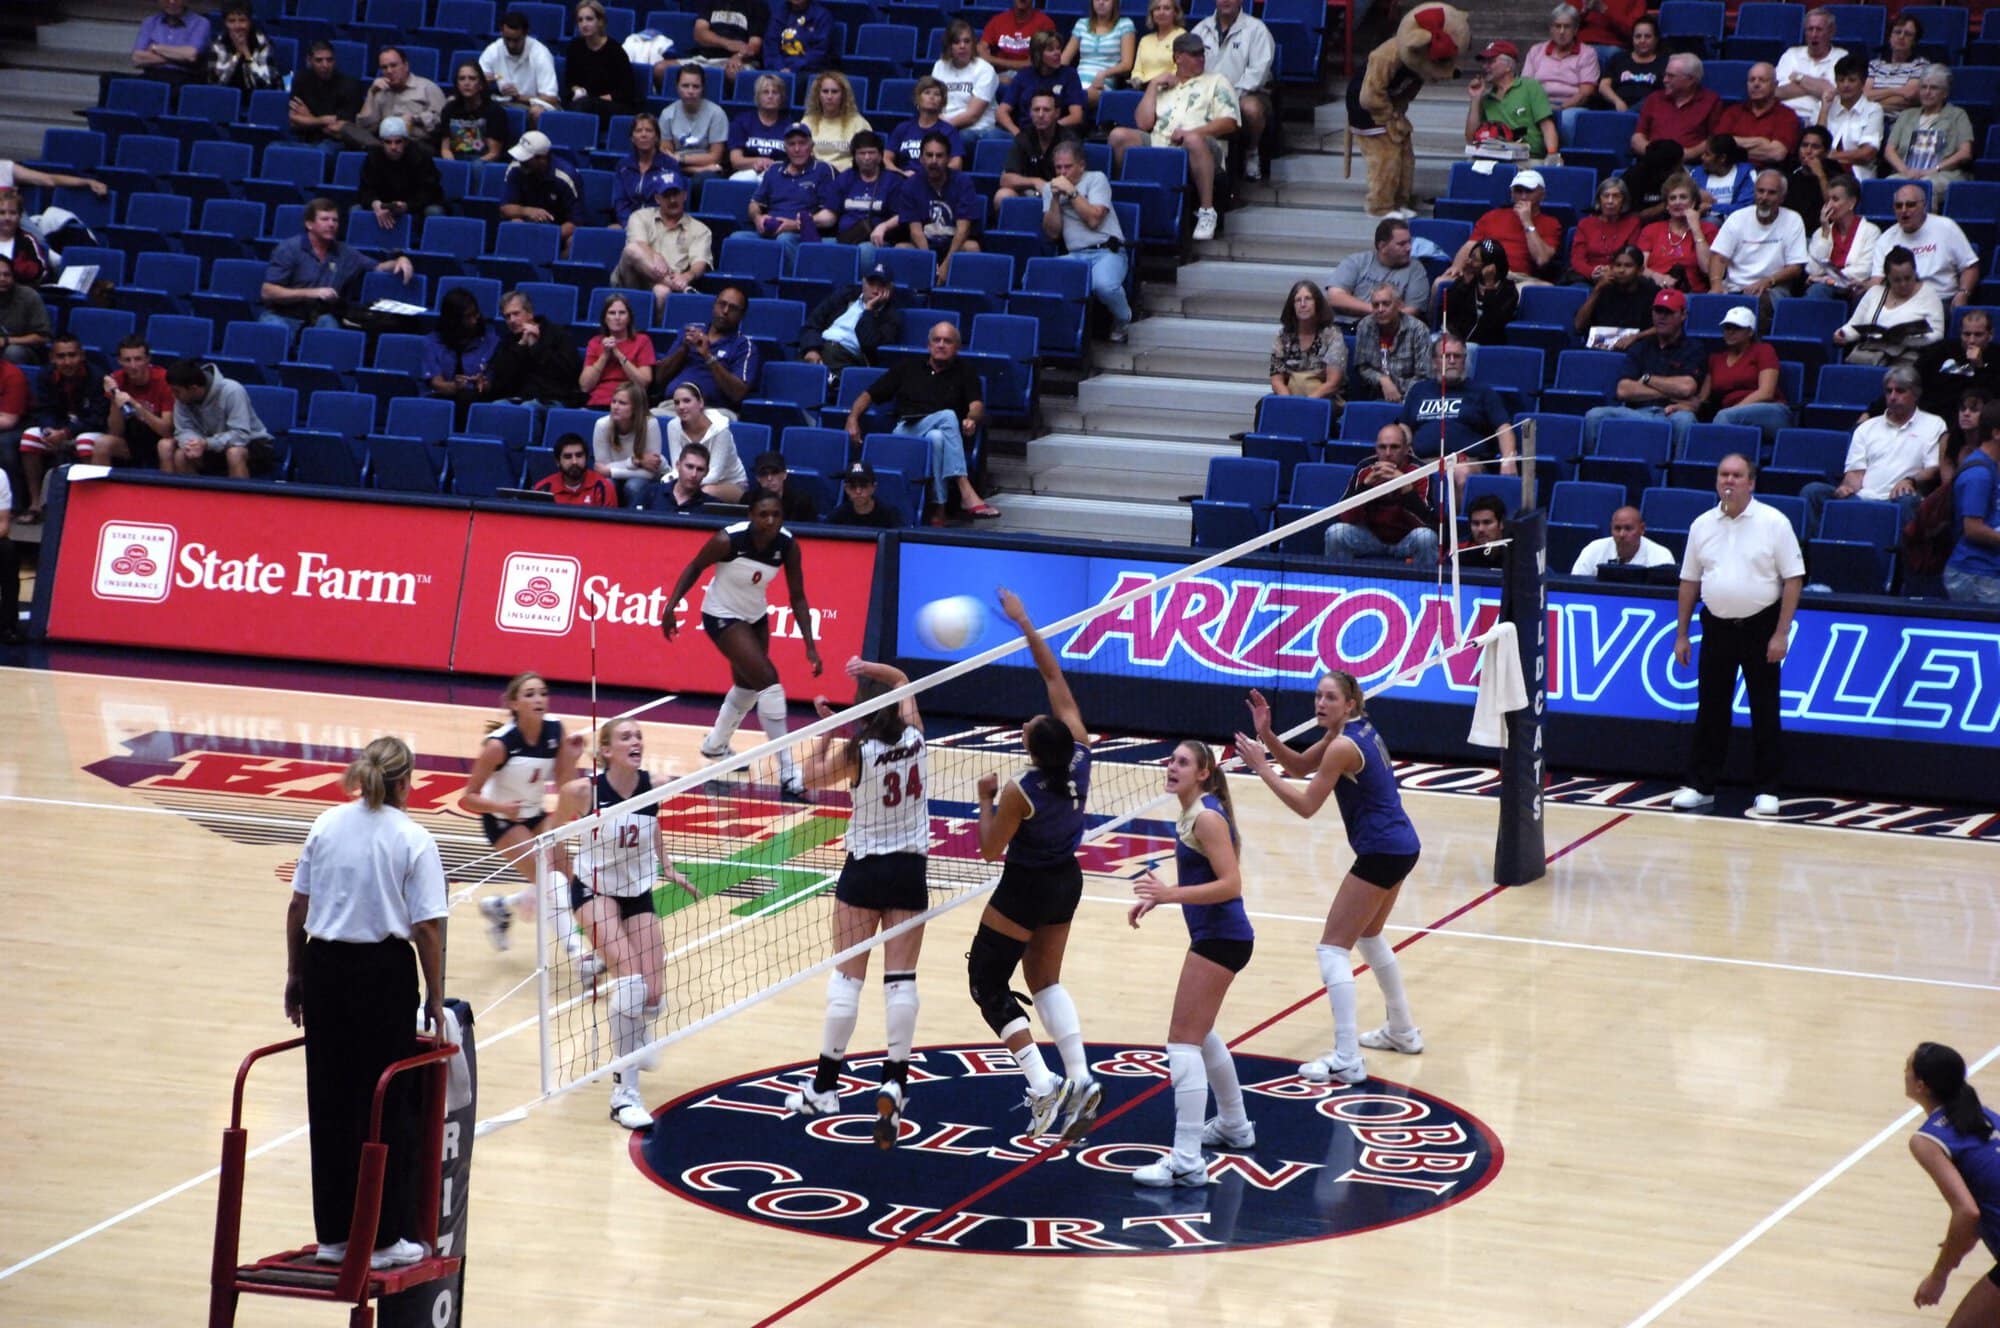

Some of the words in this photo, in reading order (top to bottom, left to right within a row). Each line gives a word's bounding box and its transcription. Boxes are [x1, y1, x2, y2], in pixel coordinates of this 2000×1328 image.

[1418, 399, 1462, 415] UMC
[175, 543, 285, 595] State
[291, 551, 417, 605] Farm
[515, 563, 541, 573] STATE
[544, 566, 569, 575] FARM
[507, 611, 562, 624] INSURANCE
[578, 575, 688, 628] State
[1061, 571, 1563, 698] ARIZON
[1532, 548, 1546, 821] WILDCATS
[882, 763, 923, 808] 34
[620, 824, 640, 849] 12
[1743, 797, 2000, 841] CHA
[804, 1113, 1328, 1191] OLSON
[1241, 1074, 1478, 1196] BOBBI
[680, 1160, 1227, 1251] COURT
